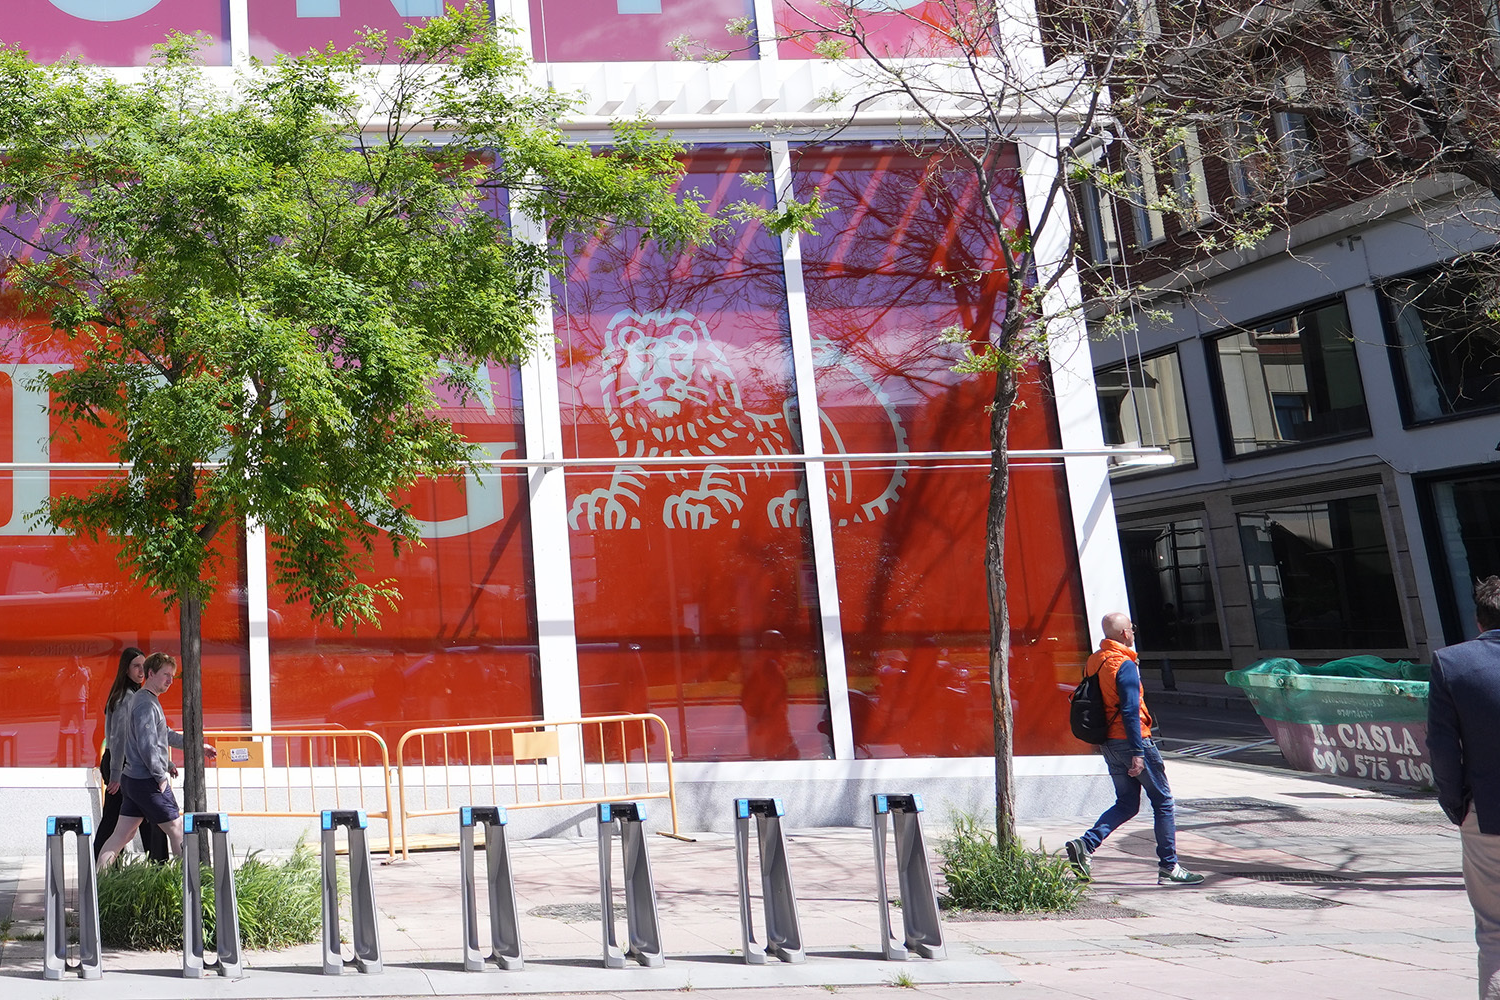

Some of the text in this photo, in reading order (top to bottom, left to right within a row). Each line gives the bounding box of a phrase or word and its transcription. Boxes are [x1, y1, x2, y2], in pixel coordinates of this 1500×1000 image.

[1337, 723, 1422, 757] CASLA
[1312, 747, 1435, 787] 696 575 169
